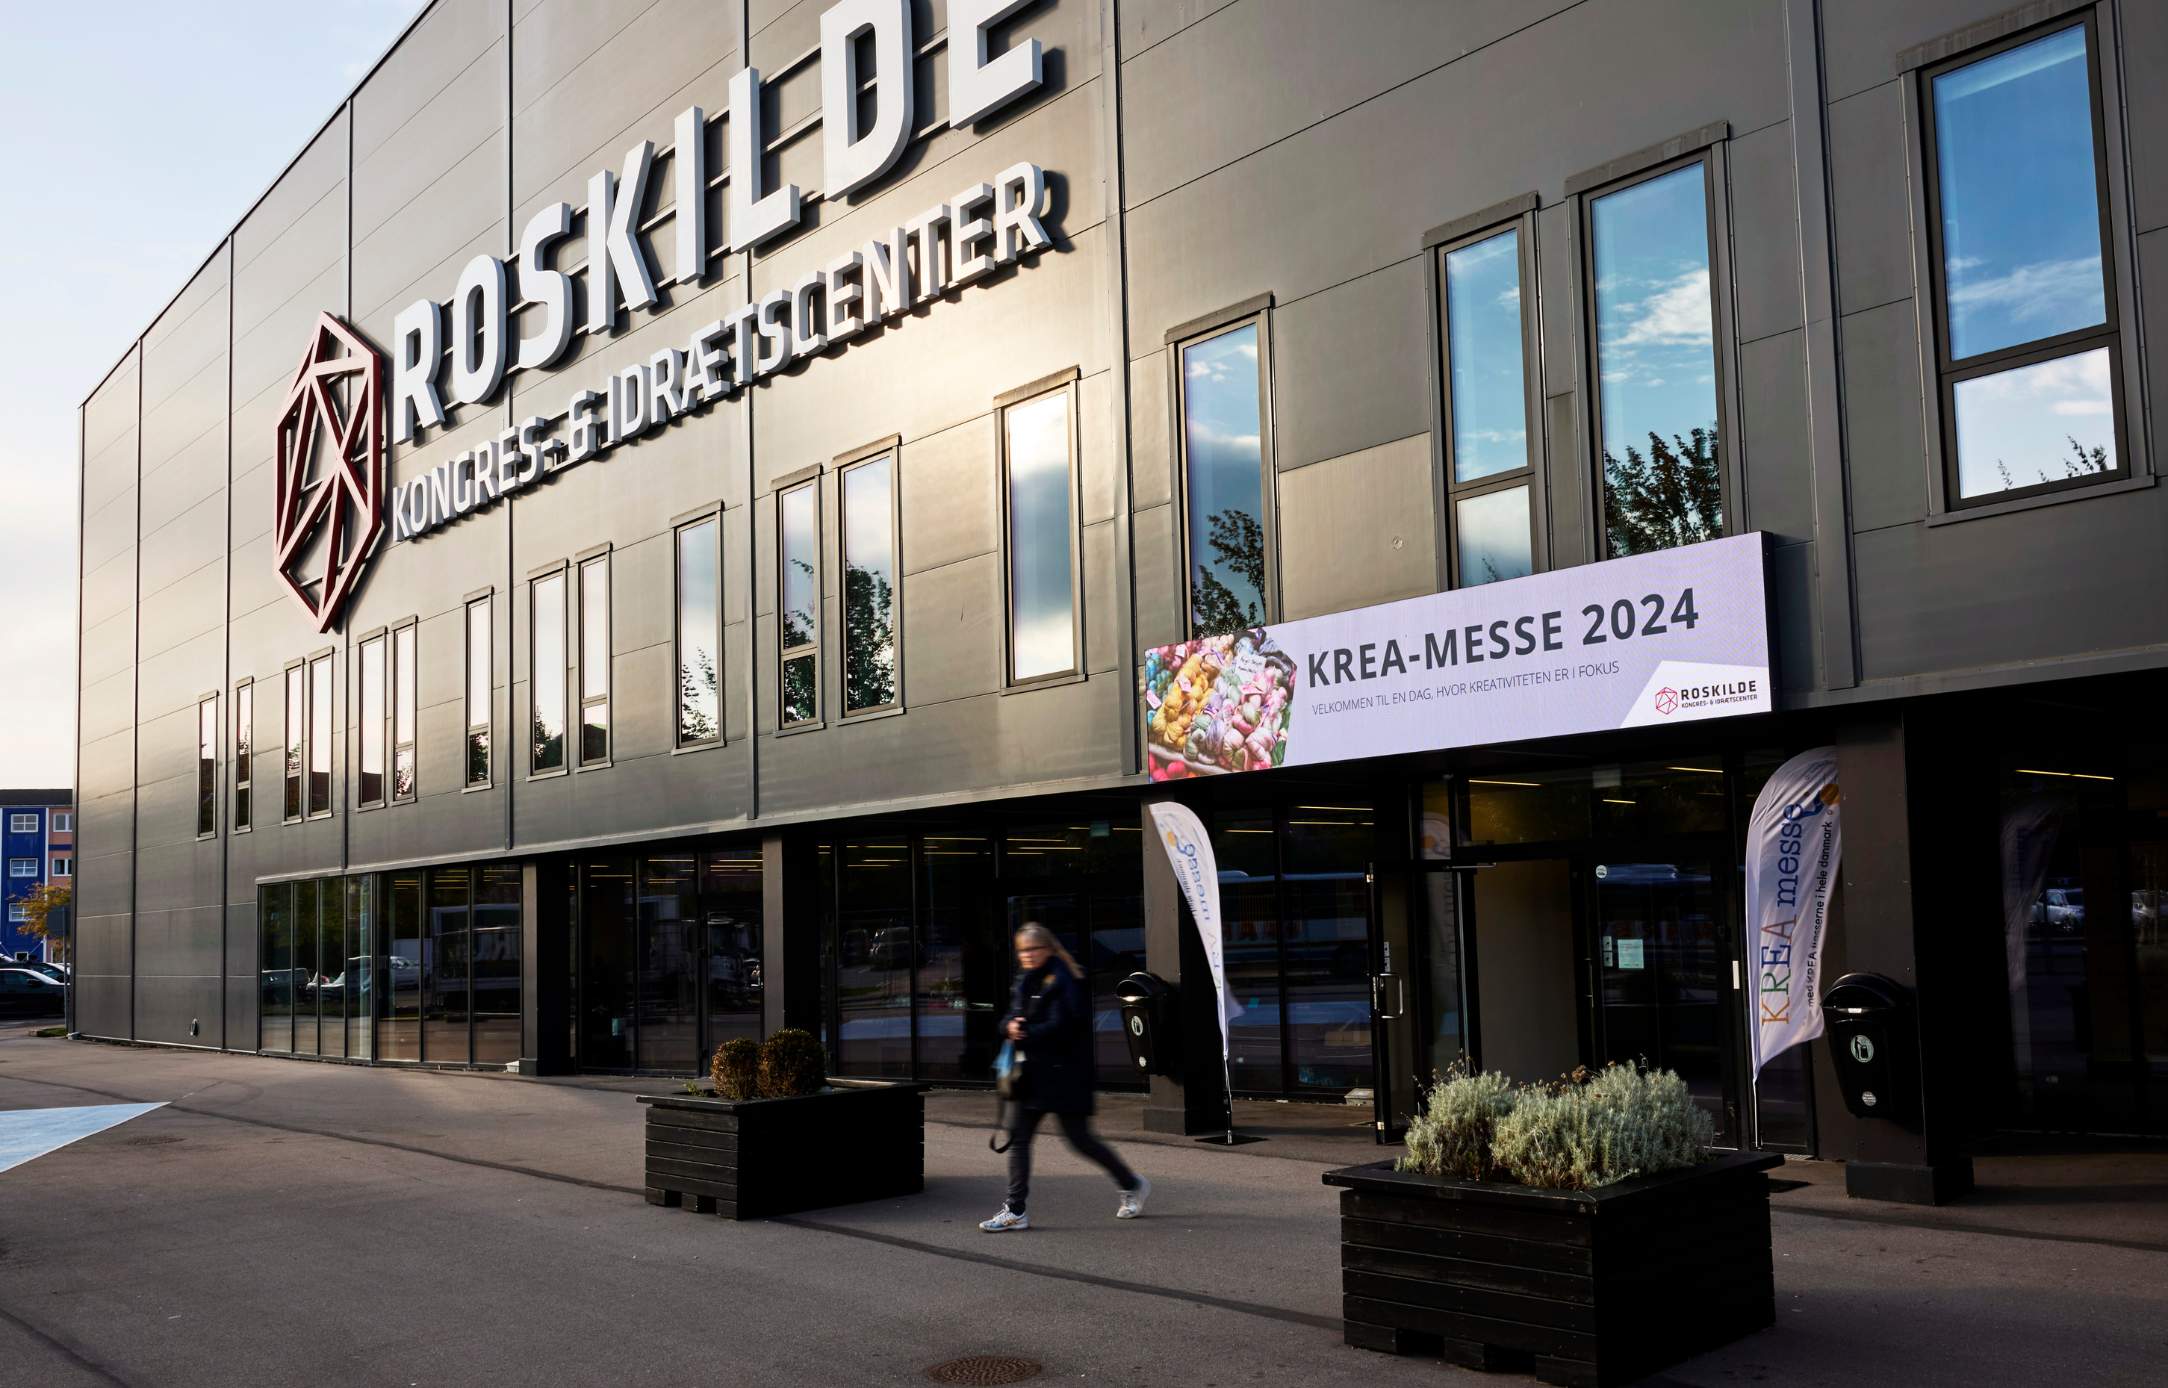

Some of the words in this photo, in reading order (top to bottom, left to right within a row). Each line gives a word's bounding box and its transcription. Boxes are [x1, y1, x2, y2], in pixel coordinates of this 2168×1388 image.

[394, 0, 1043, 444] ROSKILDE
[393, 416, 563, 542] KONGRES-
[569, 390, 600, 461] &
[608, 162, 1052, 443] IDRÆTSCENTER
[1307, 610, 1563, 688] KREA-MESSE
[1581, 588, 1699, 646] 2024
[1312, 697, 1373, 715] VELKOMMEN
[1376, 695, 1390, 707] TIL
[1392, 692, 1406, 704] EN
[1409, 687, 1434, 702] DAG,
[1436, 681, 1468, 698] HVOR
[1469, 671, 1551, 694] KREATIVITETEN
[1554, 668, 1570, 682] ER
[1572, 666, 1576, 679] I
[1578, 660, 1620, 678] FOKUS
[1680, 680, 1757, 701] ROSKILDE
[1681, 701, 1708, 709] KONGRES-
[1777, 803, 1803, 908] messe
[1816, 870, 1828, 893] hele
[1818, 821, 1833, 868] danmark
[1760, 914, 1797, 1026] KREA
